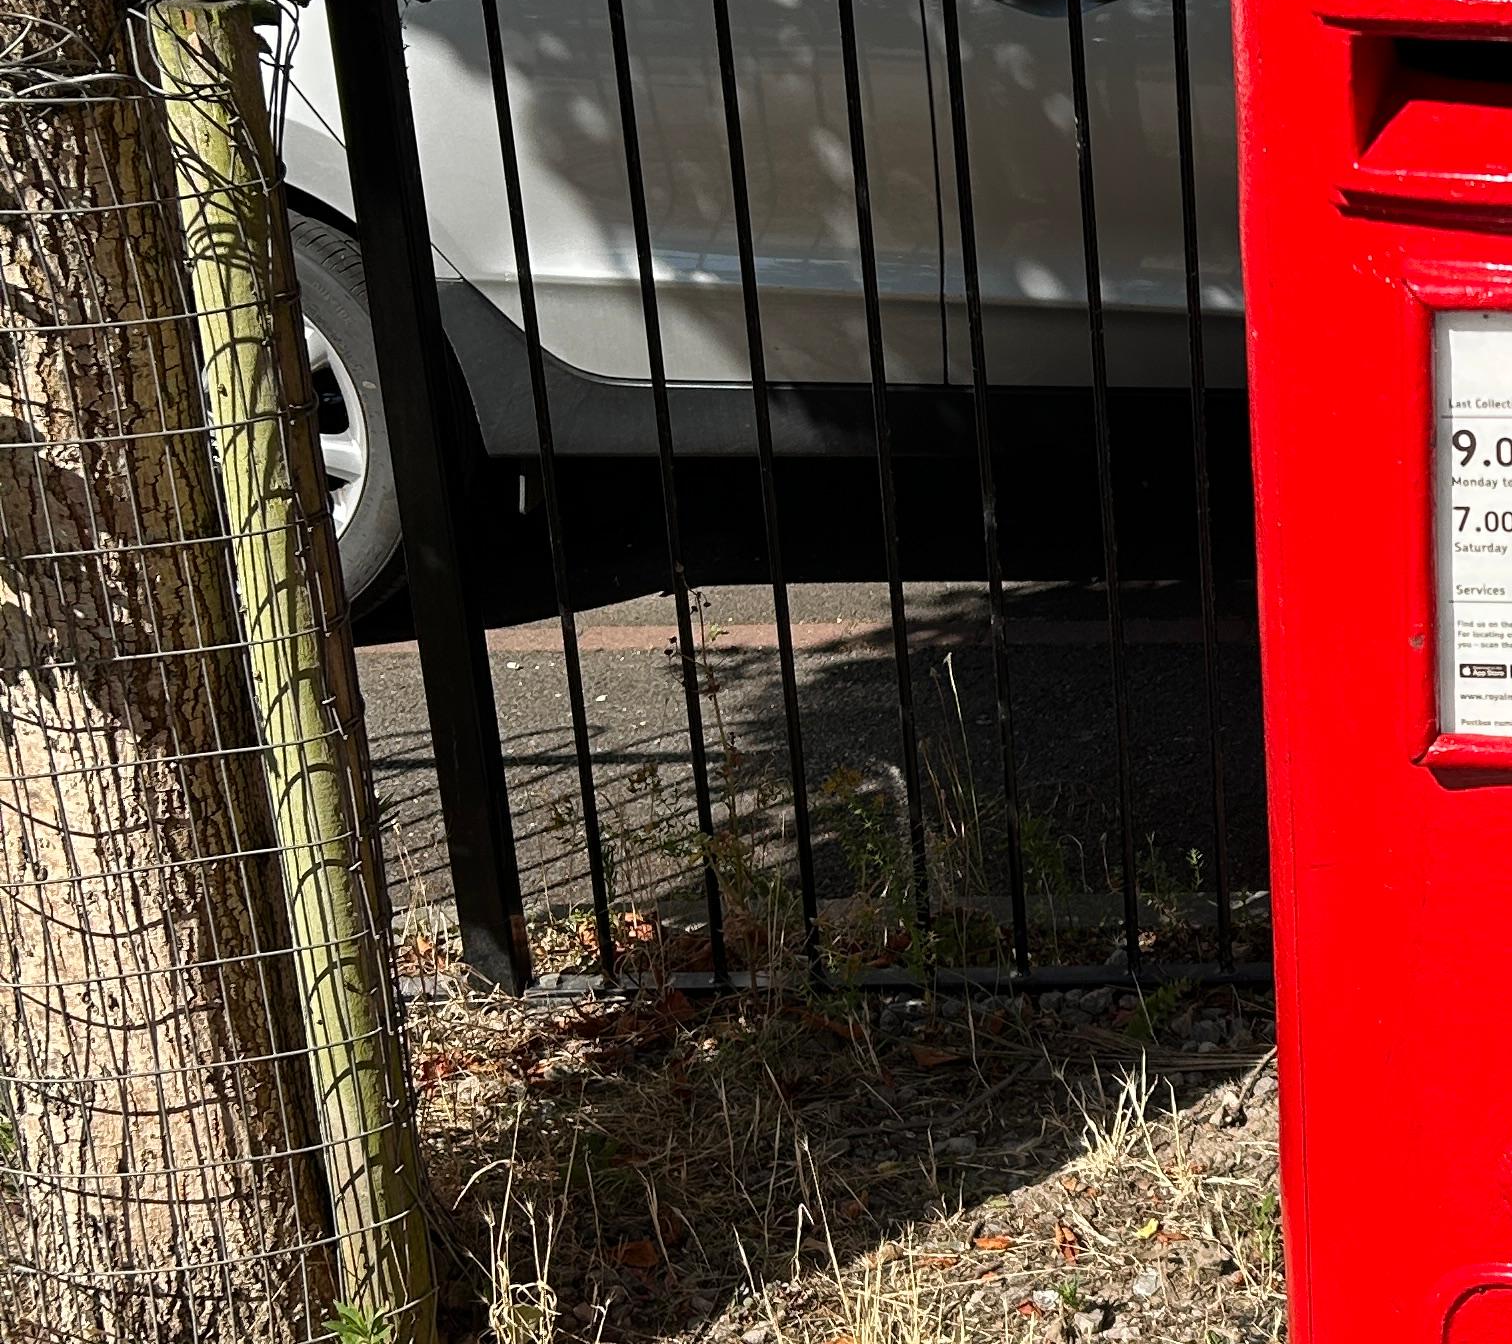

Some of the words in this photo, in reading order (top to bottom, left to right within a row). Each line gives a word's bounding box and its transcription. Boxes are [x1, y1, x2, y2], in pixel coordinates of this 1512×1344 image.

[1448, 398, 1471, 409] Last
[1451, 476, 1498, 490] Monday
[1454, 541, 1508, 555] Saturday
[1456, 584, 1506, 596] Services
[1457, 620, 1474, 628] Find
[1457, 630, 1470, 638] For
[1472, 631, 1504, 640] locating
[1457, 641, 1472, 650] you
[1480, 641, 1499, 649] scan
